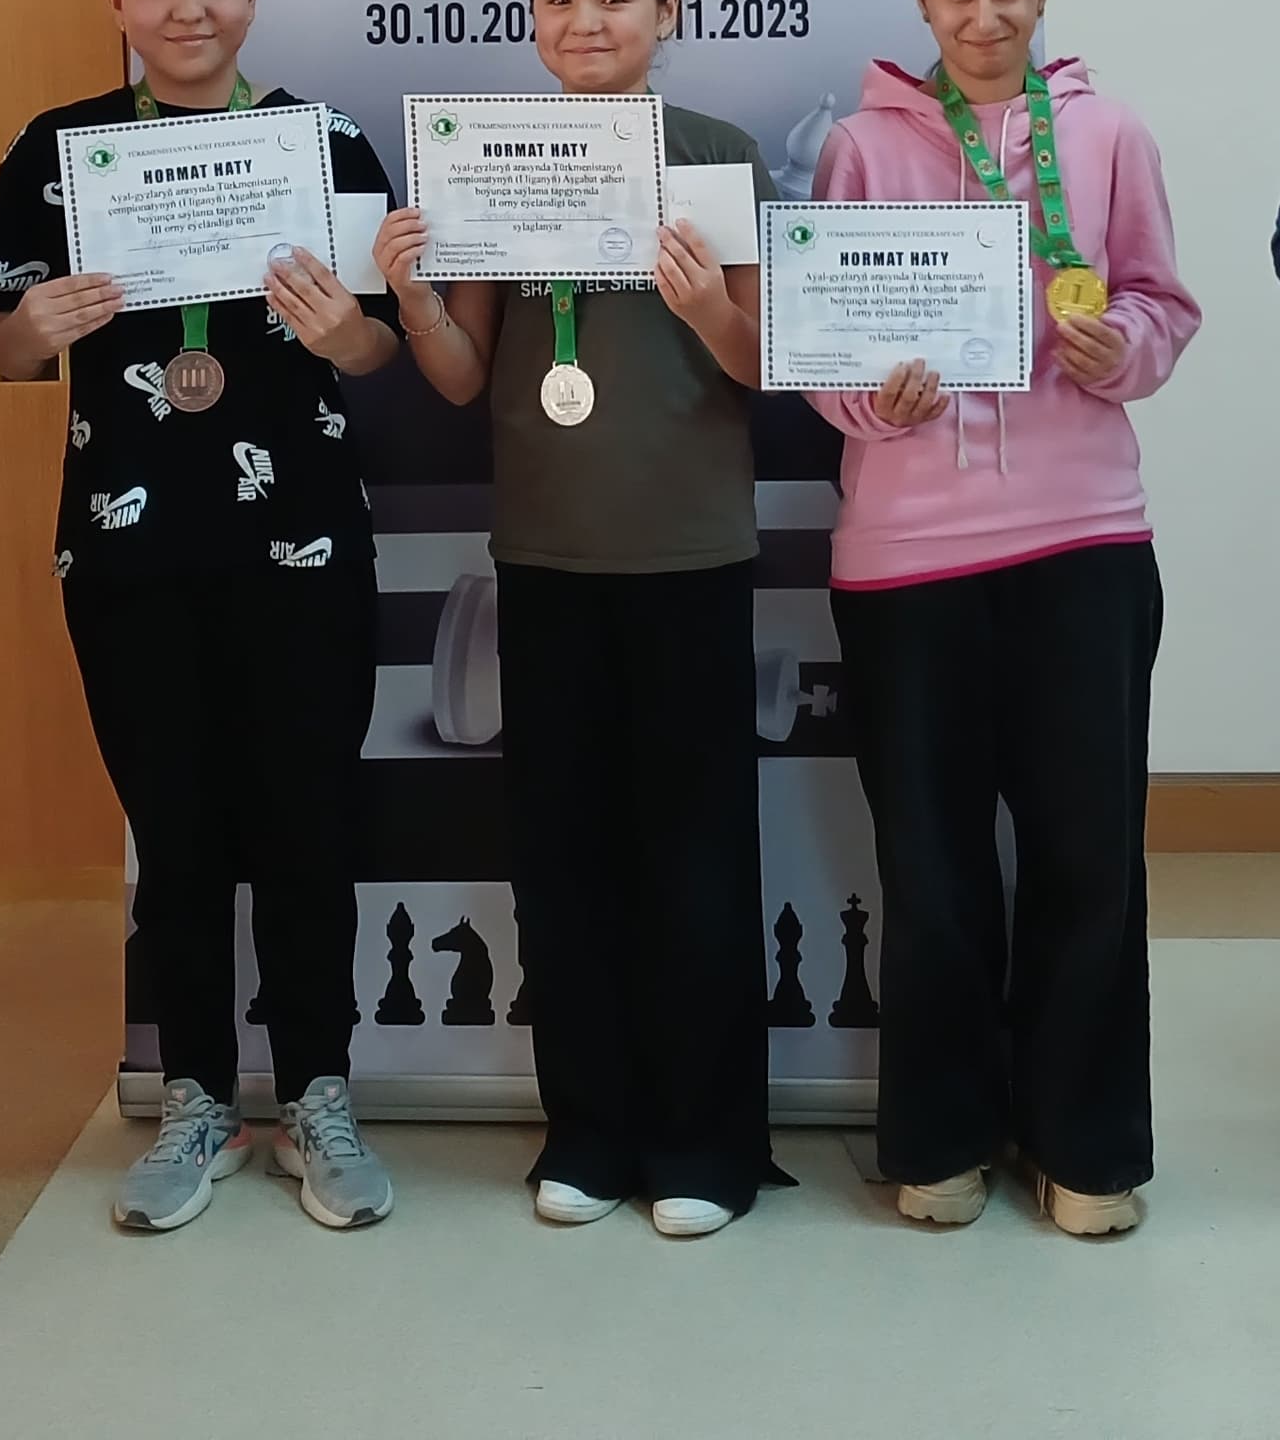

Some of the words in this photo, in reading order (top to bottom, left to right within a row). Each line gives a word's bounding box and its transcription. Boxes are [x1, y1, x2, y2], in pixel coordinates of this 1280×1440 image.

[366, 1, 536, 45] 30.10.20
[327, 116, 361, 139] NIK
[483, 143, 545, 158] HORMAT
[550, 143, 588, 158] HATY
[143, 163, 208, 185] HORMAT
[213, 159, 252, 177] HATY
[840, 251, 905, 267] HORMAT
[910, 251, 949, 267] HATY
[521, 281, 582, 298] SHAM
[586, 279, 606, 293] EL
[147, 394, 171, 422] AIR
[249, 448, 275, 485] NIKE
[237, 477, 257, 502] AIR
[90, 492, 111, 513] AIR
[101, 502, 141, 530] NIKE
[269, 540, 296, 560] AIR
